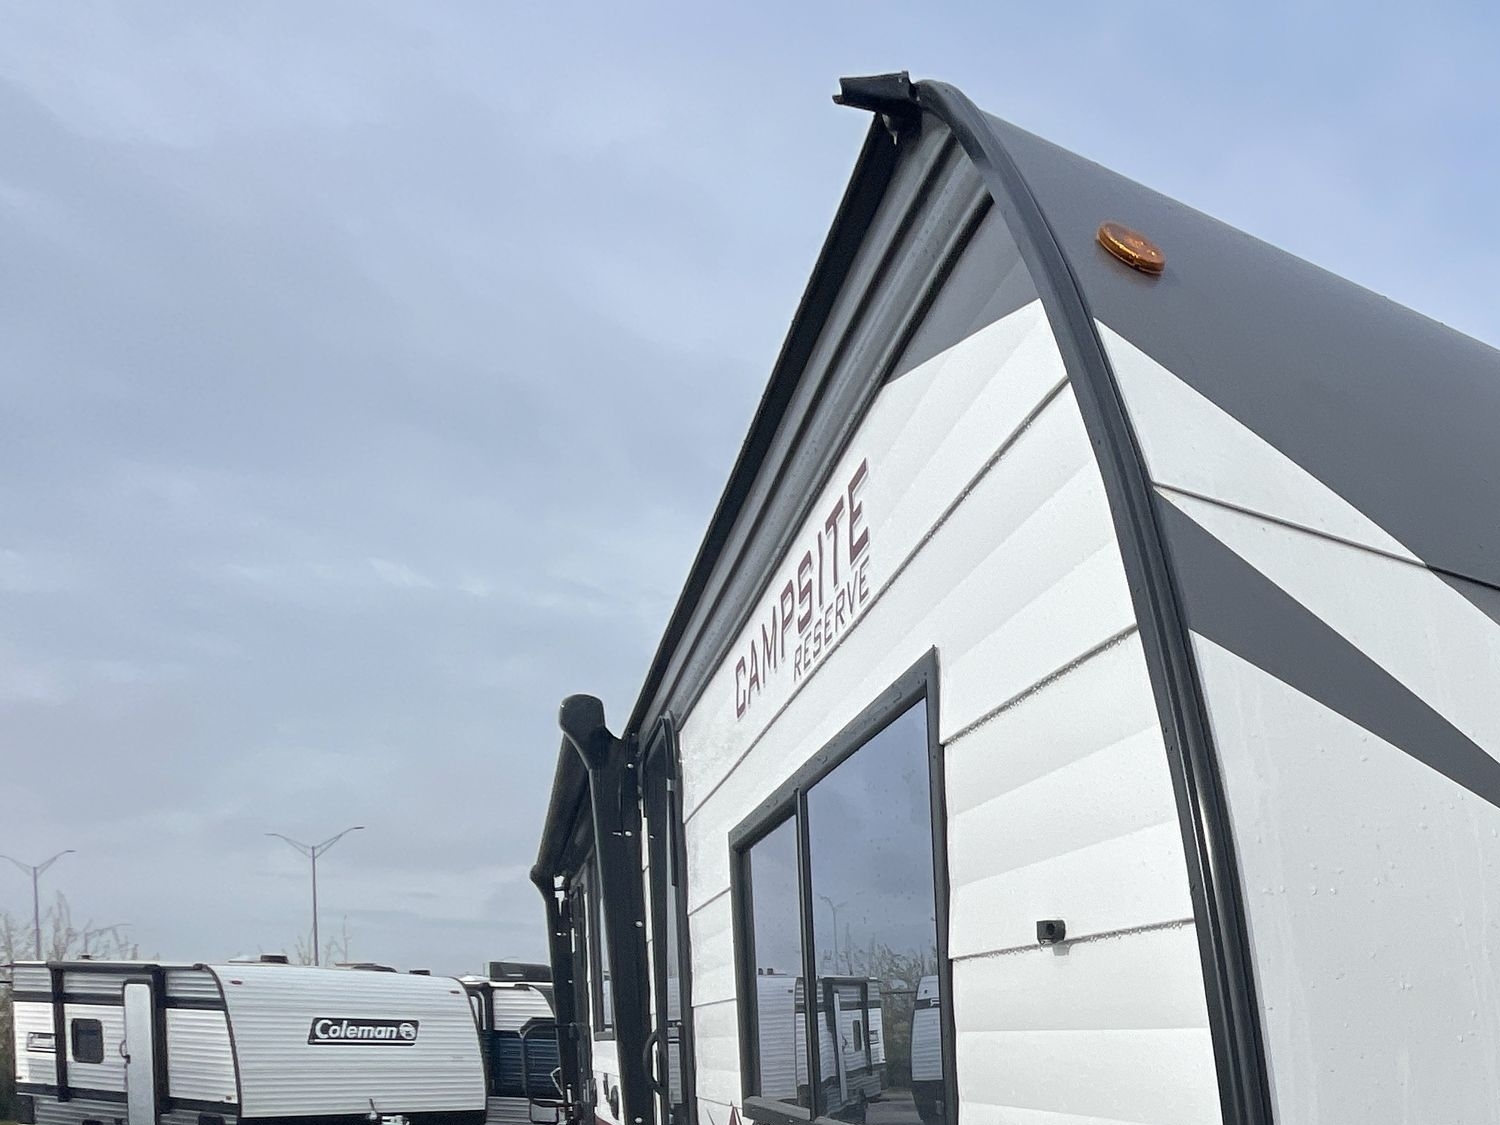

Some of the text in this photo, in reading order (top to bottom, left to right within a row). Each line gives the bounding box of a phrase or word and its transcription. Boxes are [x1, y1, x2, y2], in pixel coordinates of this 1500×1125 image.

[736, 457, 870, 720] CAMPSITE
[794, 554, 870, 682] RESERVE
[315, 1019, 398, 1039] Coleman
